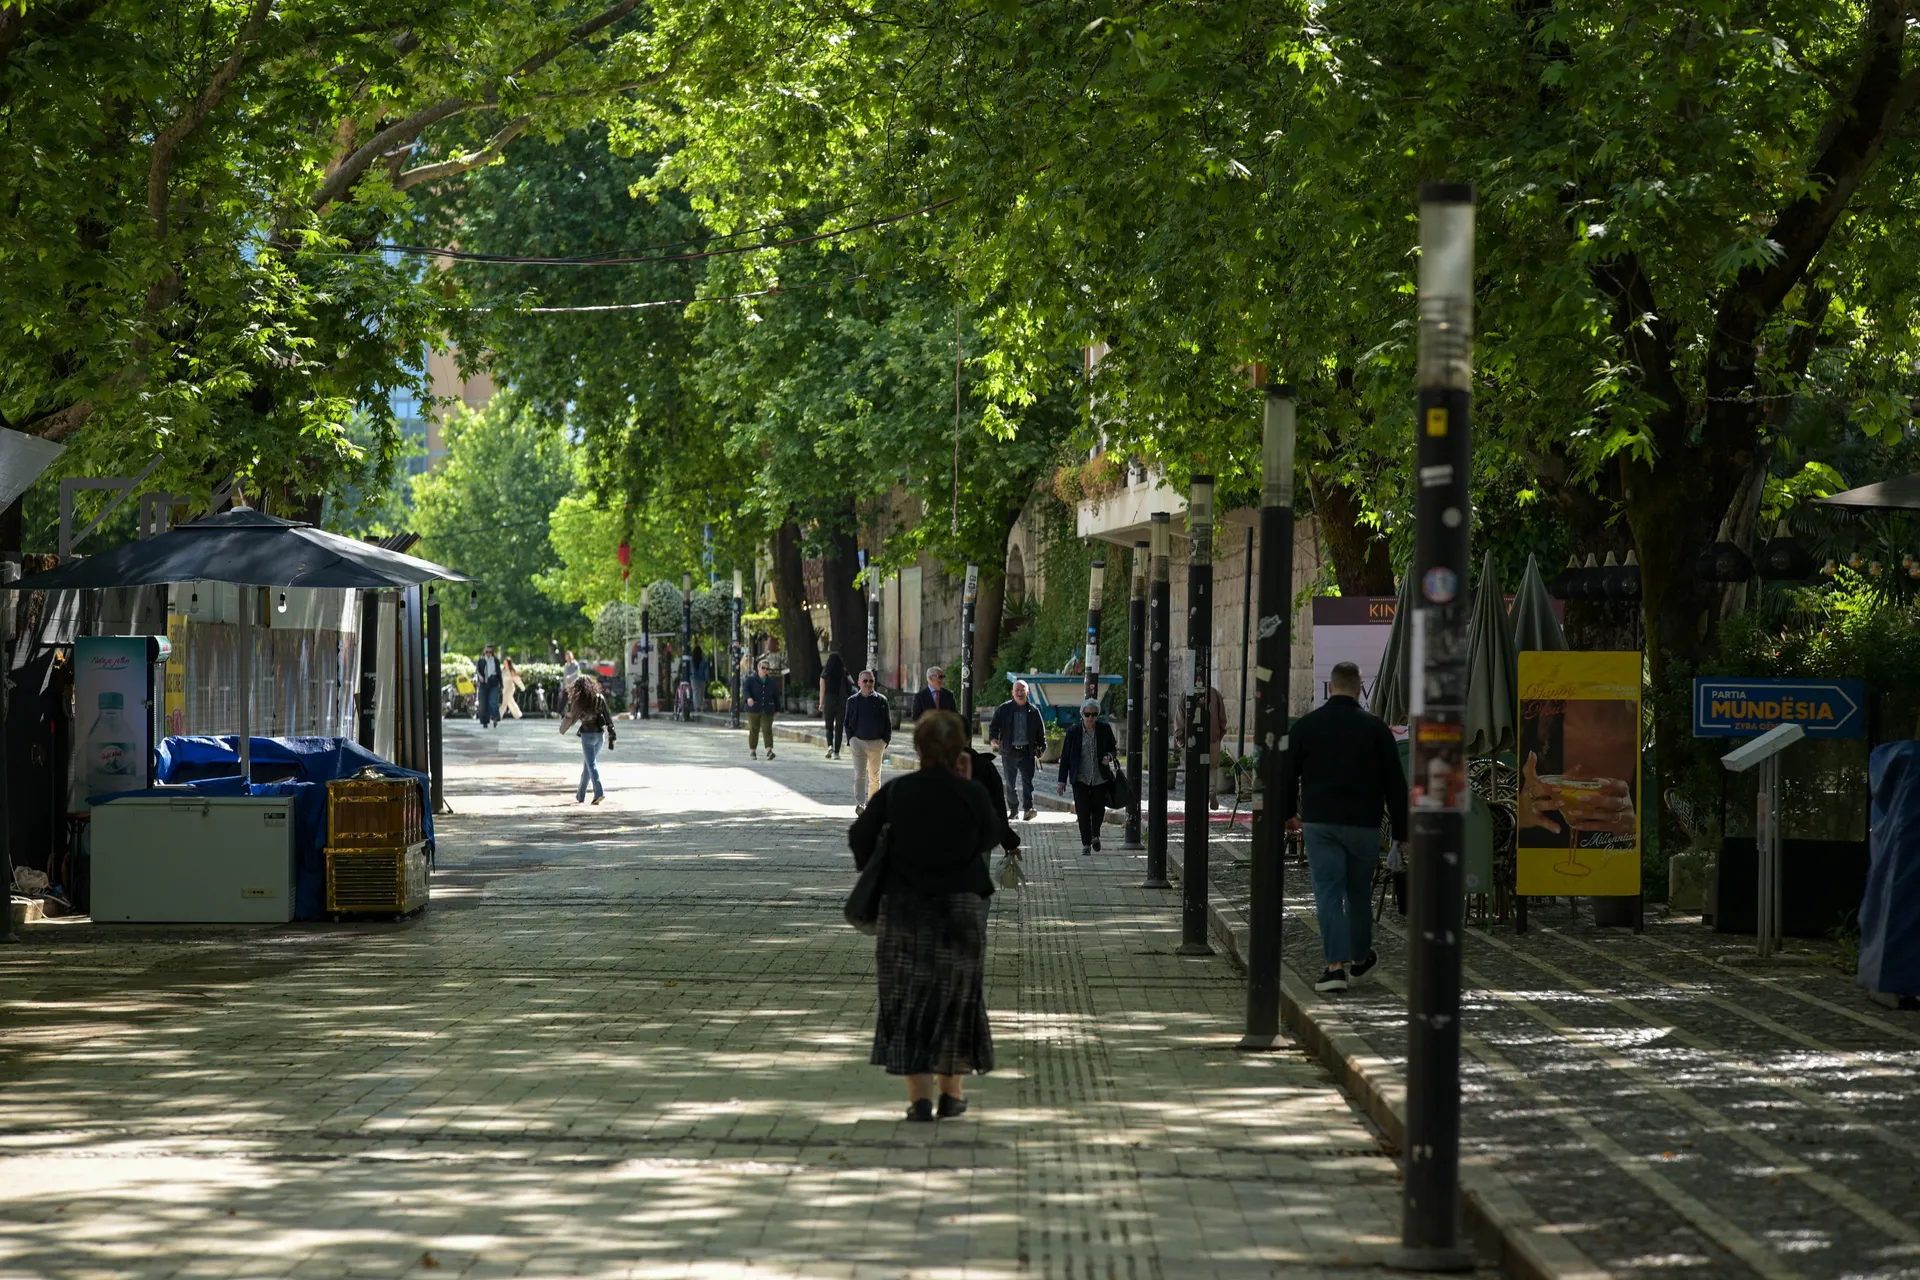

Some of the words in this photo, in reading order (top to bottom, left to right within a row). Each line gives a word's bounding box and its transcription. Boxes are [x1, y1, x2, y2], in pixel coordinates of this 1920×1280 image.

[1521, 683, 1576, 701] Happy
[1711, 690, 1747, 699] PARTIA
[1711, 696, 1834, 720] MUNDËSIA
[1734, 722, 1758, 731] ZYRA
[1580, 832, 1640, 848] Millennium
